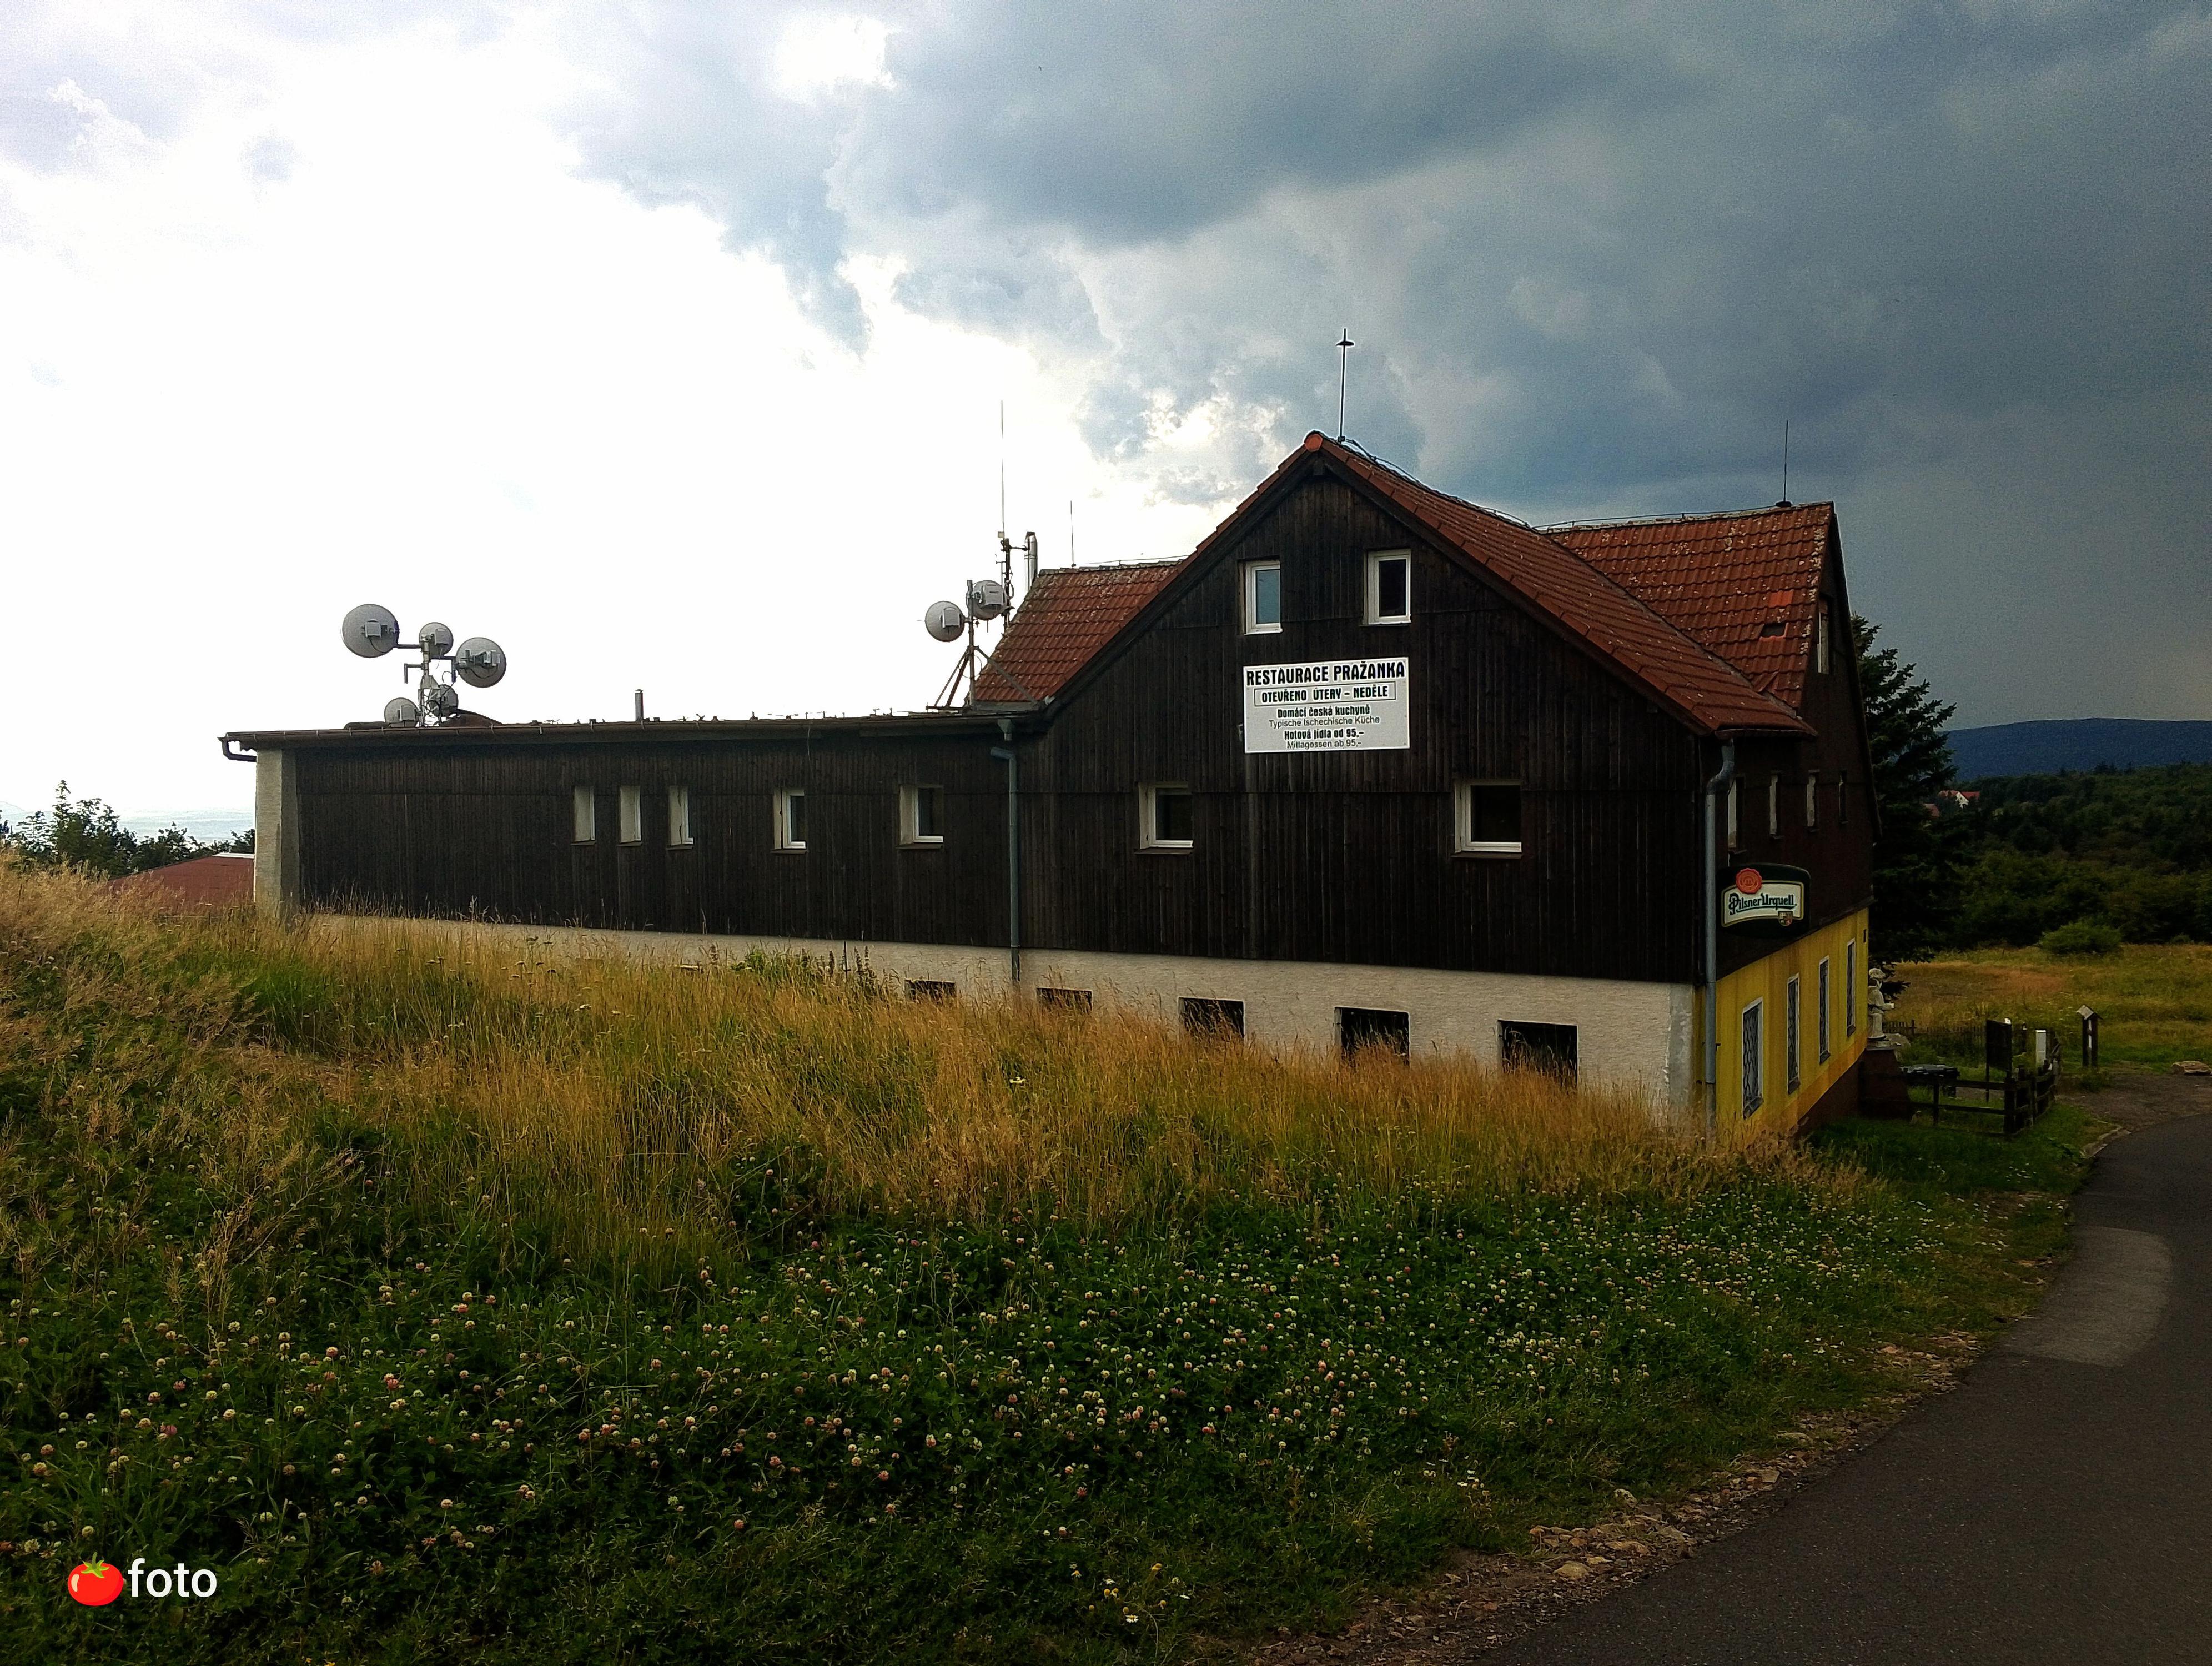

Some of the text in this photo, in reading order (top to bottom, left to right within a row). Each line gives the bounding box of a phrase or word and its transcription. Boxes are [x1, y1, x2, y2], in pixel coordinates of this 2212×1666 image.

[1246, 661, 1405, 686] RESTAURACE PRAŽANKA
[1261, 689, 1306, 702] OTEVŘENO
[1353, 684, 1388, 698] NEDĚLE
[1278, 704, 1370, 718] Domácí česká kuchyně
[1269, 716, 1380, 729] Typische tschechische Küche
[1284, 729, 1311, 740] Hotová
[1314, 729, 1331, 739] jídla
[1334, 729, 1344, 739] od
[1287, 740, 1332, 750] Mittagessen
[1334, 739, 1344, 747] ab
[1728, 892, 1795, 915] Pilsner Urquell
